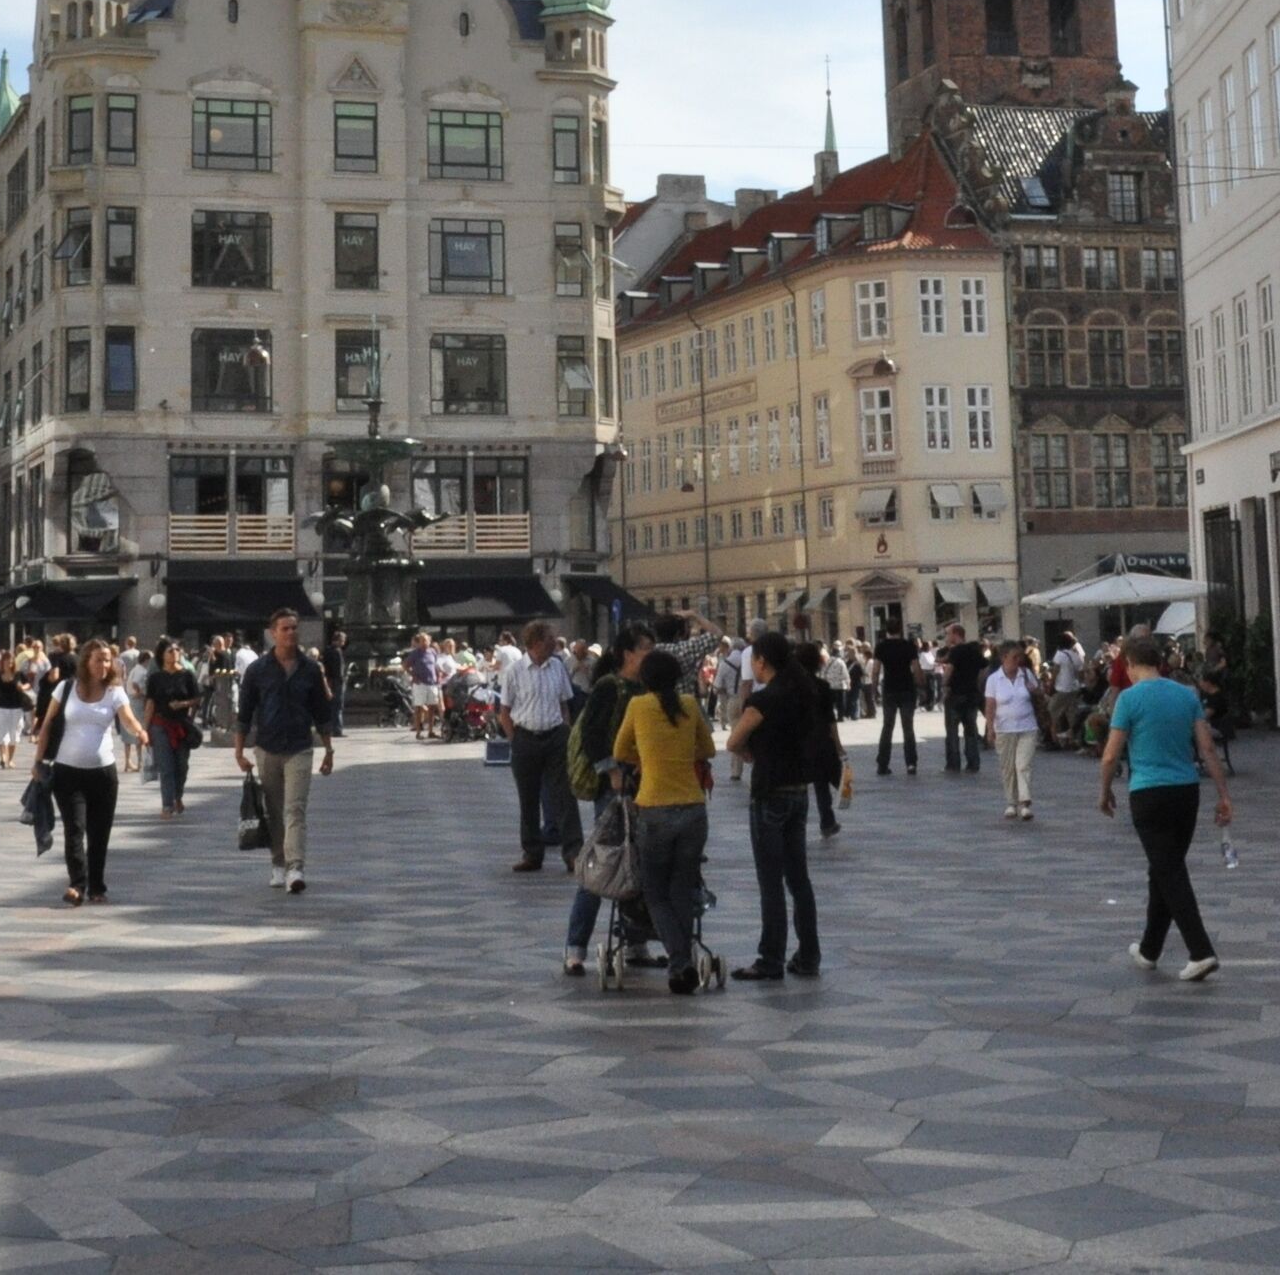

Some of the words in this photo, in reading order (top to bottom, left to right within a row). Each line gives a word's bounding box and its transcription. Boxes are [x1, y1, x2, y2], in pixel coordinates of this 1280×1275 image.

[219, 235, 242, 244] HAY
[342, 236, 364, 245] HAY
[455, 242, 476, 251] HAY
[219, 353, 242, 362] HAY
[457, 357, 478, 366] HAY
[1127, 556, 1186, 566] Danske
